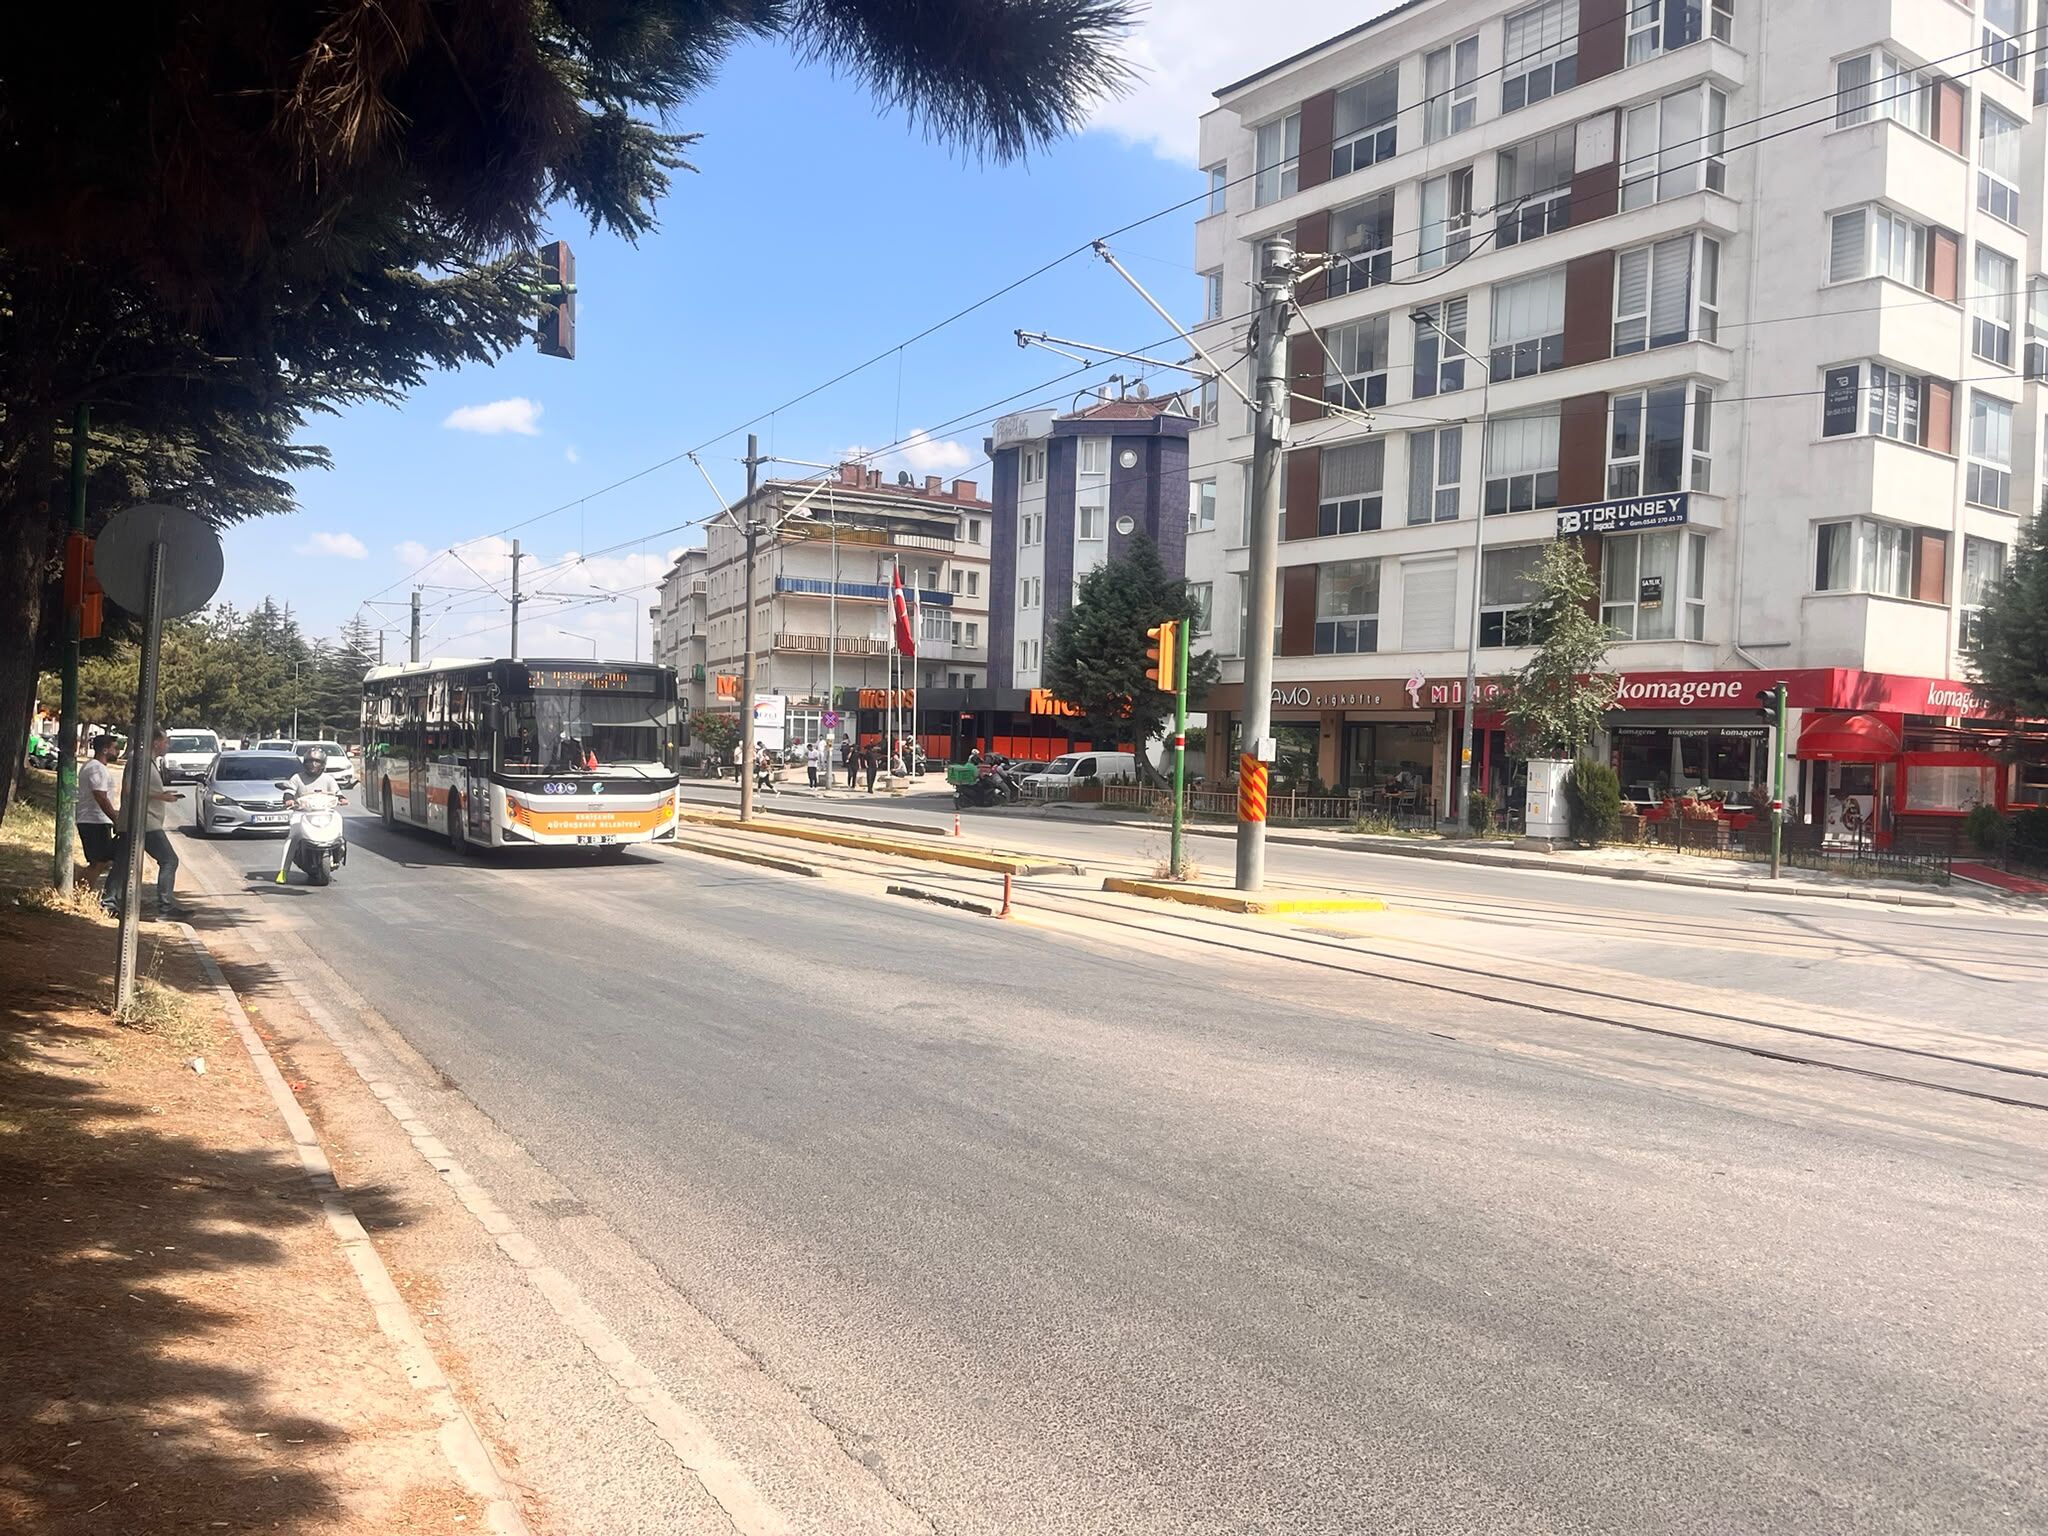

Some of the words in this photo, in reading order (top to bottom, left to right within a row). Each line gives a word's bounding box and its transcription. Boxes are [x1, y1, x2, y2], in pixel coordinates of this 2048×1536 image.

[1581, 497, 1681, 523] TORUNBEY
[1617, 676, 1742, 706] komagene
[1667, 728, 1709, 737] komagene
[1720, 728, 1764, 737] komagene
